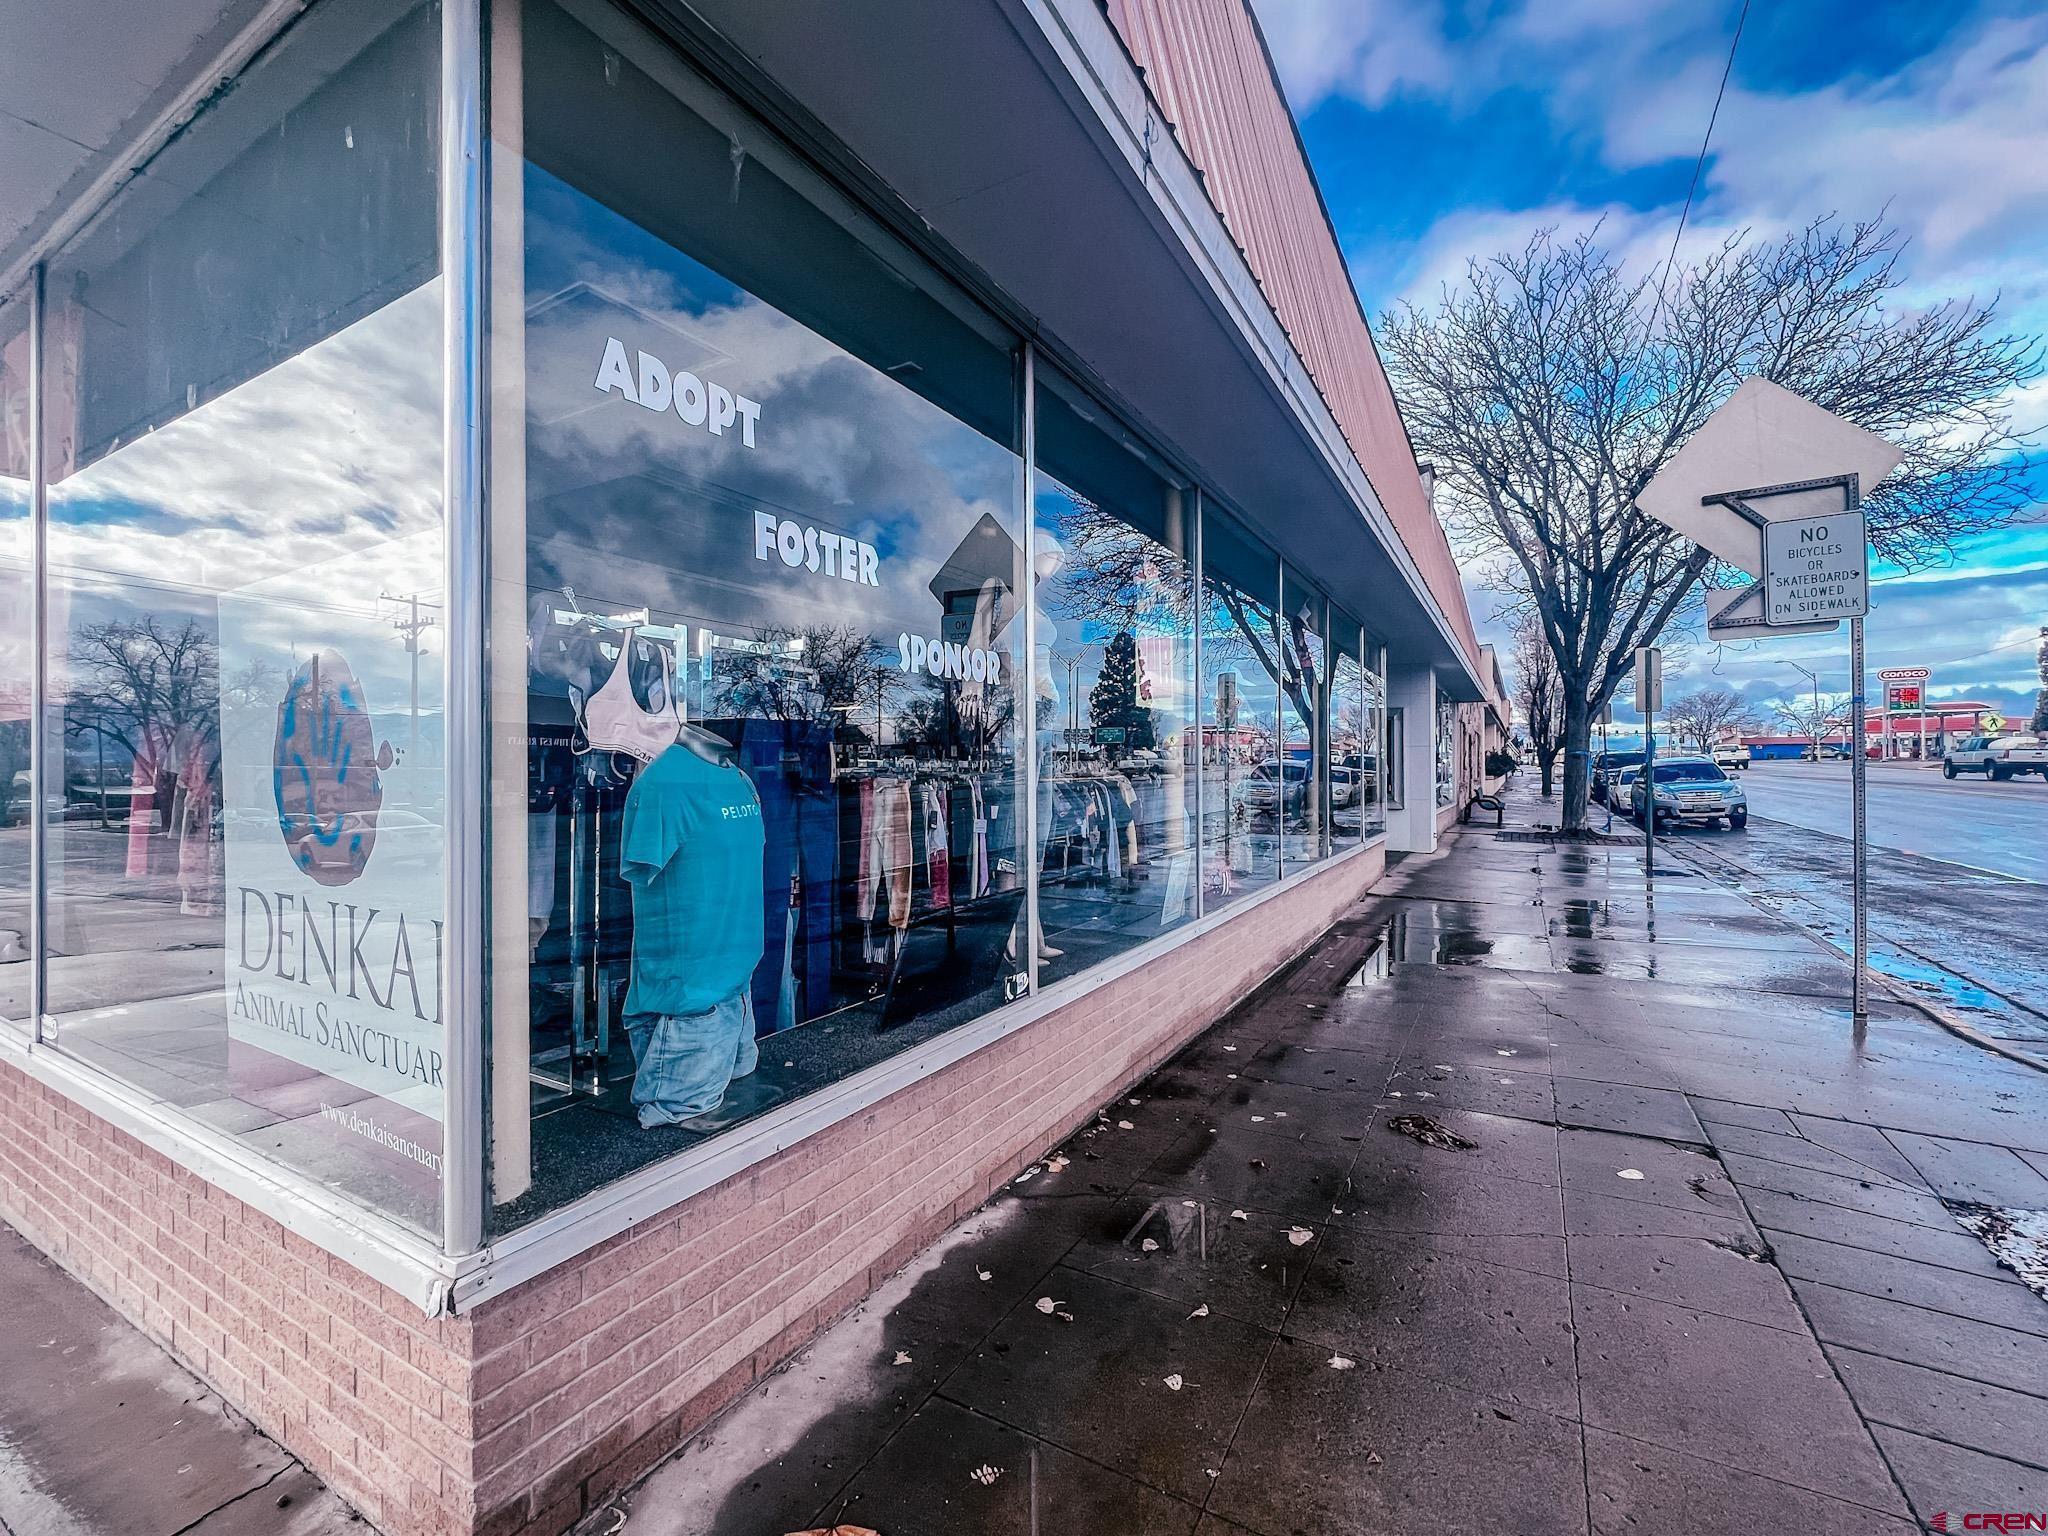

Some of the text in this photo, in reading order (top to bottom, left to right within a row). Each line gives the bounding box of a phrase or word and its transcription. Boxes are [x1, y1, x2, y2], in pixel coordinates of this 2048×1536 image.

[594, 336, 761, 449] ADOPT
[1800, 526, 1828, 543] NO
[754, 510, 880, 587] FOSTER
[1788, 543, 1842, 559] BICYCLES
[1807, 560, 1823, 570] OR
[1775, 569, 1858, 587] SKATEBOARDS
[1789, 585, 1844, 600] ALLOWED
[1775, 597, 1859, 614] ON SIDEWALK
[899, 632, 1001, 686] SPONSOR
[238, 886, 444, 1026] DENKAI
[233, 978, 311, 1040] ANIMAL
